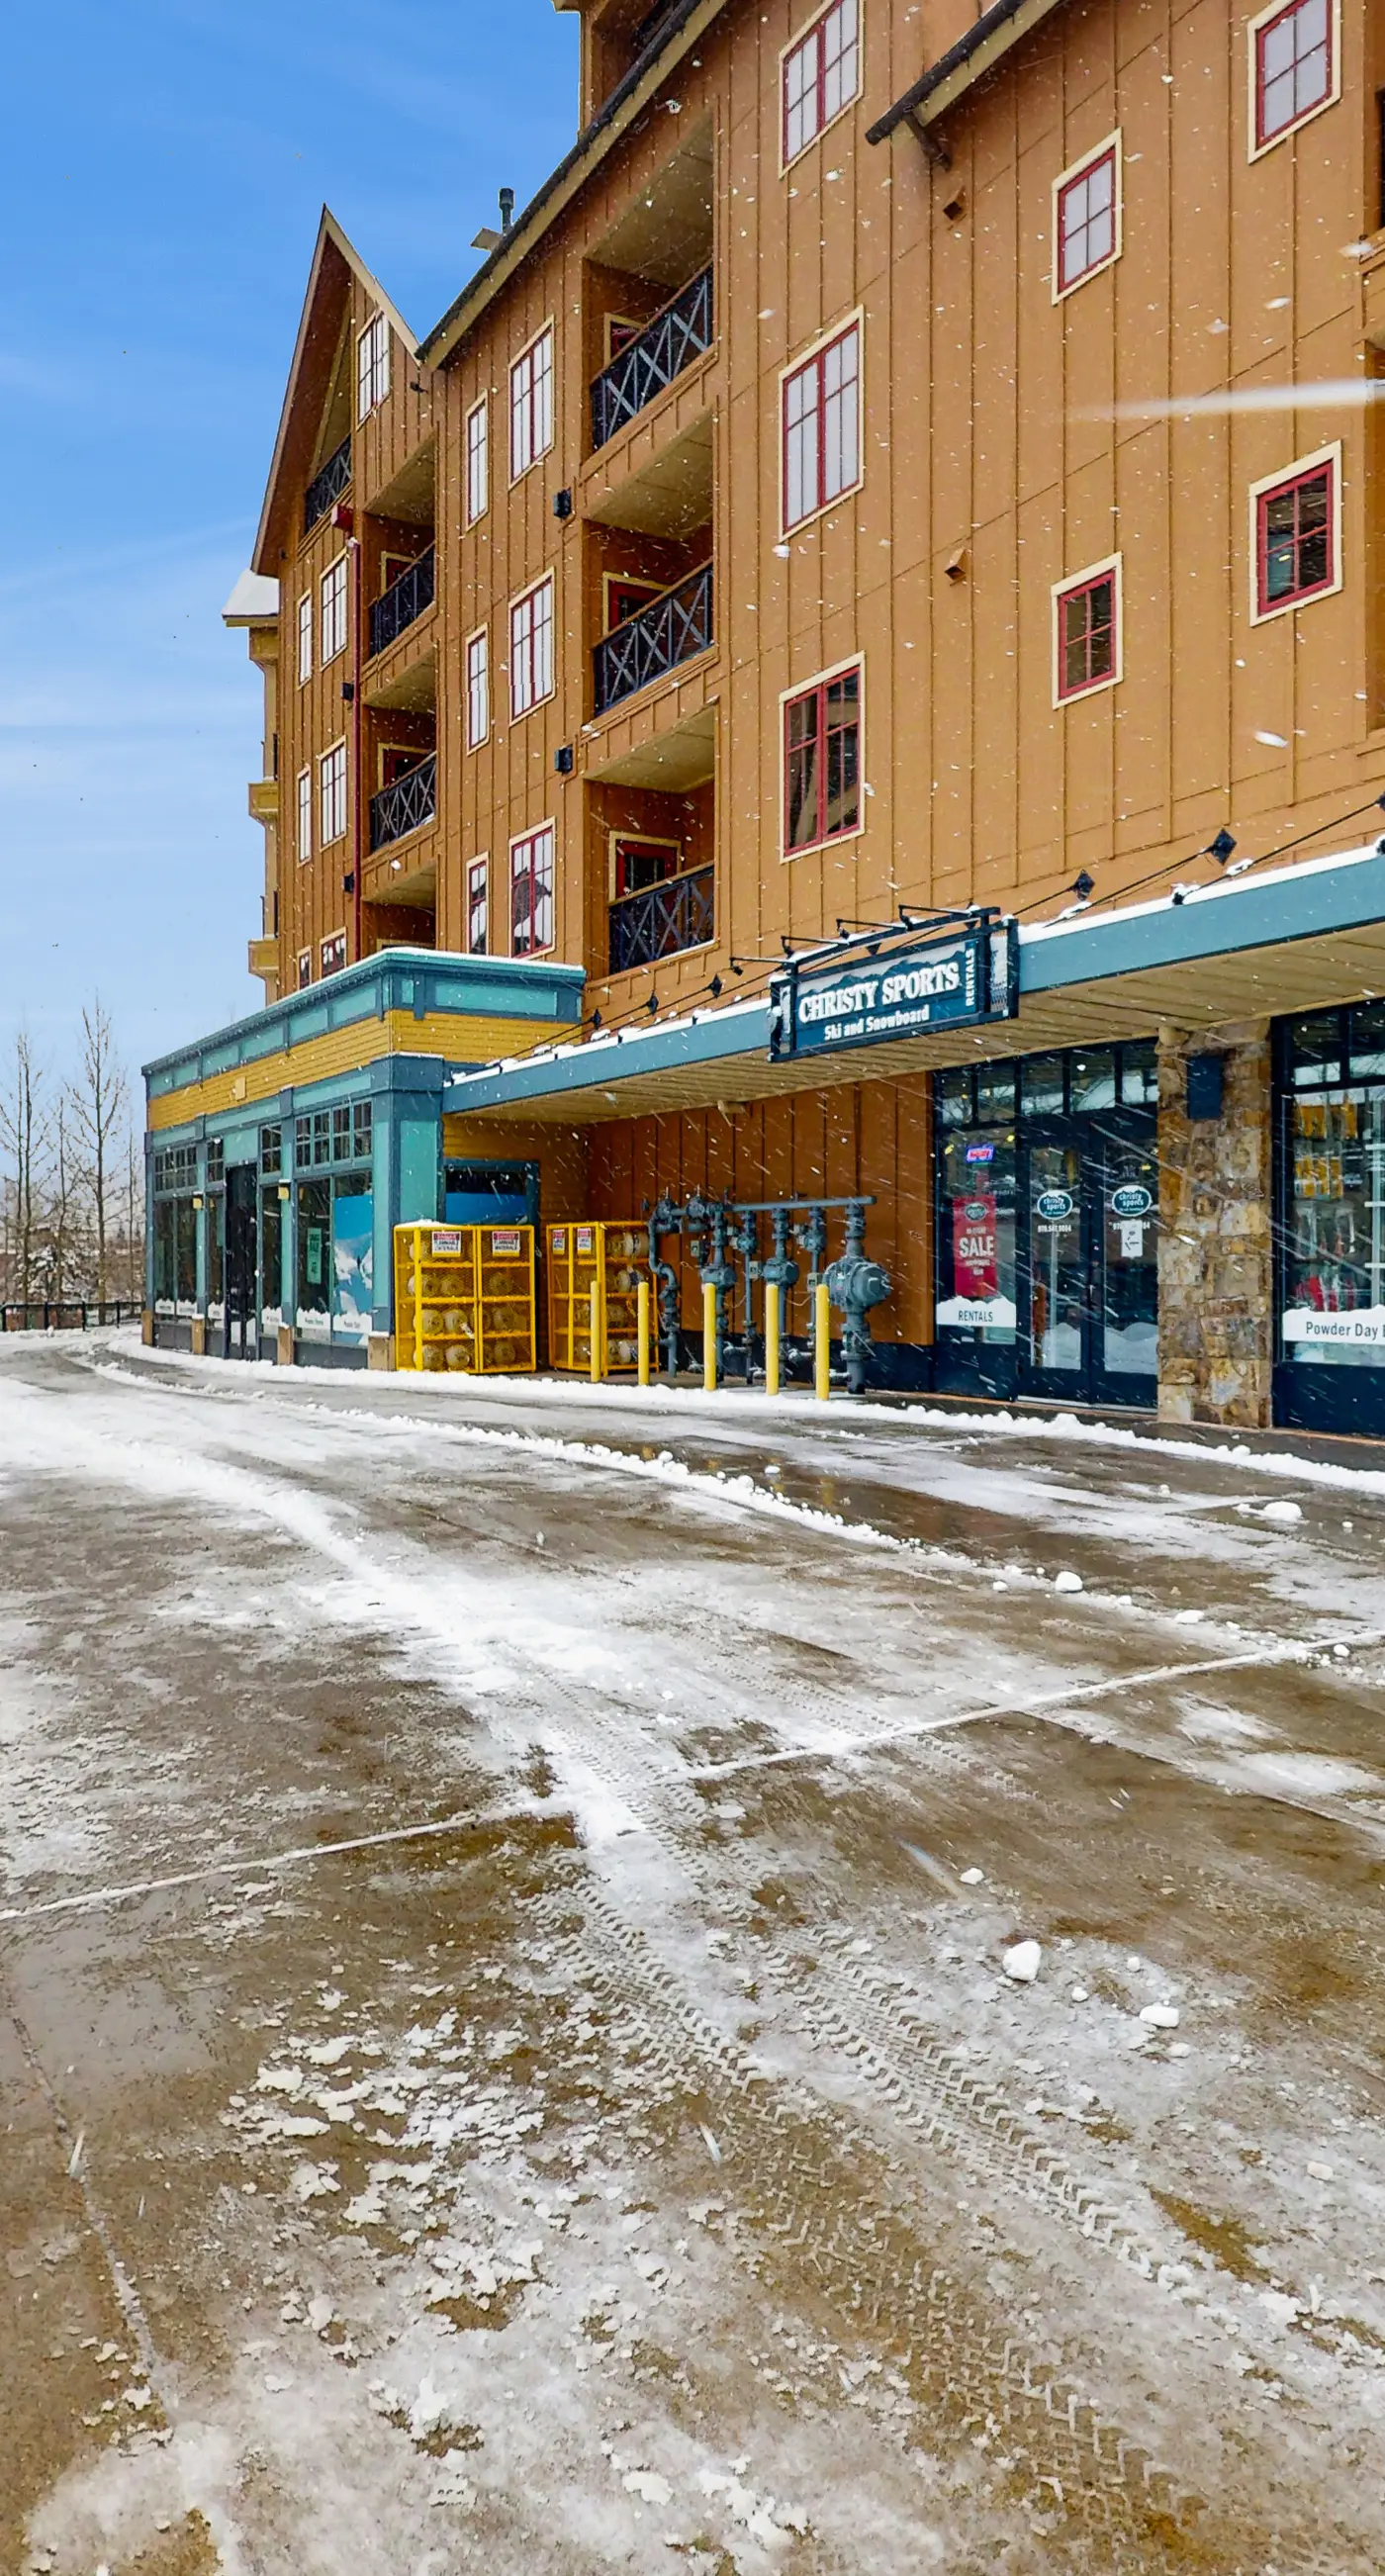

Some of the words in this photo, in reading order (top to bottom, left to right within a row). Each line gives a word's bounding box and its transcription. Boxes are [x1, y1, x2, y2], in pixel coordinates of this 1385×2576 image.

[965, 948, 975, 1007] RENTALS
[798, 980, 879, 1023] CHRISTY
[881, 962, 960, 1005] SPORTS
[824, 1023, 842, 1040] Ski
[844, 1017, 864, 1035] and
[866, 1004, 930, 1031] Snowboard
[959, 1236, 994, 1258] SALE
[958, 1310, 993, 1322] RENTALS
[1306, 1321, 1351, 1336] Powder
[1355, 1323, 1378, 1340] Day
